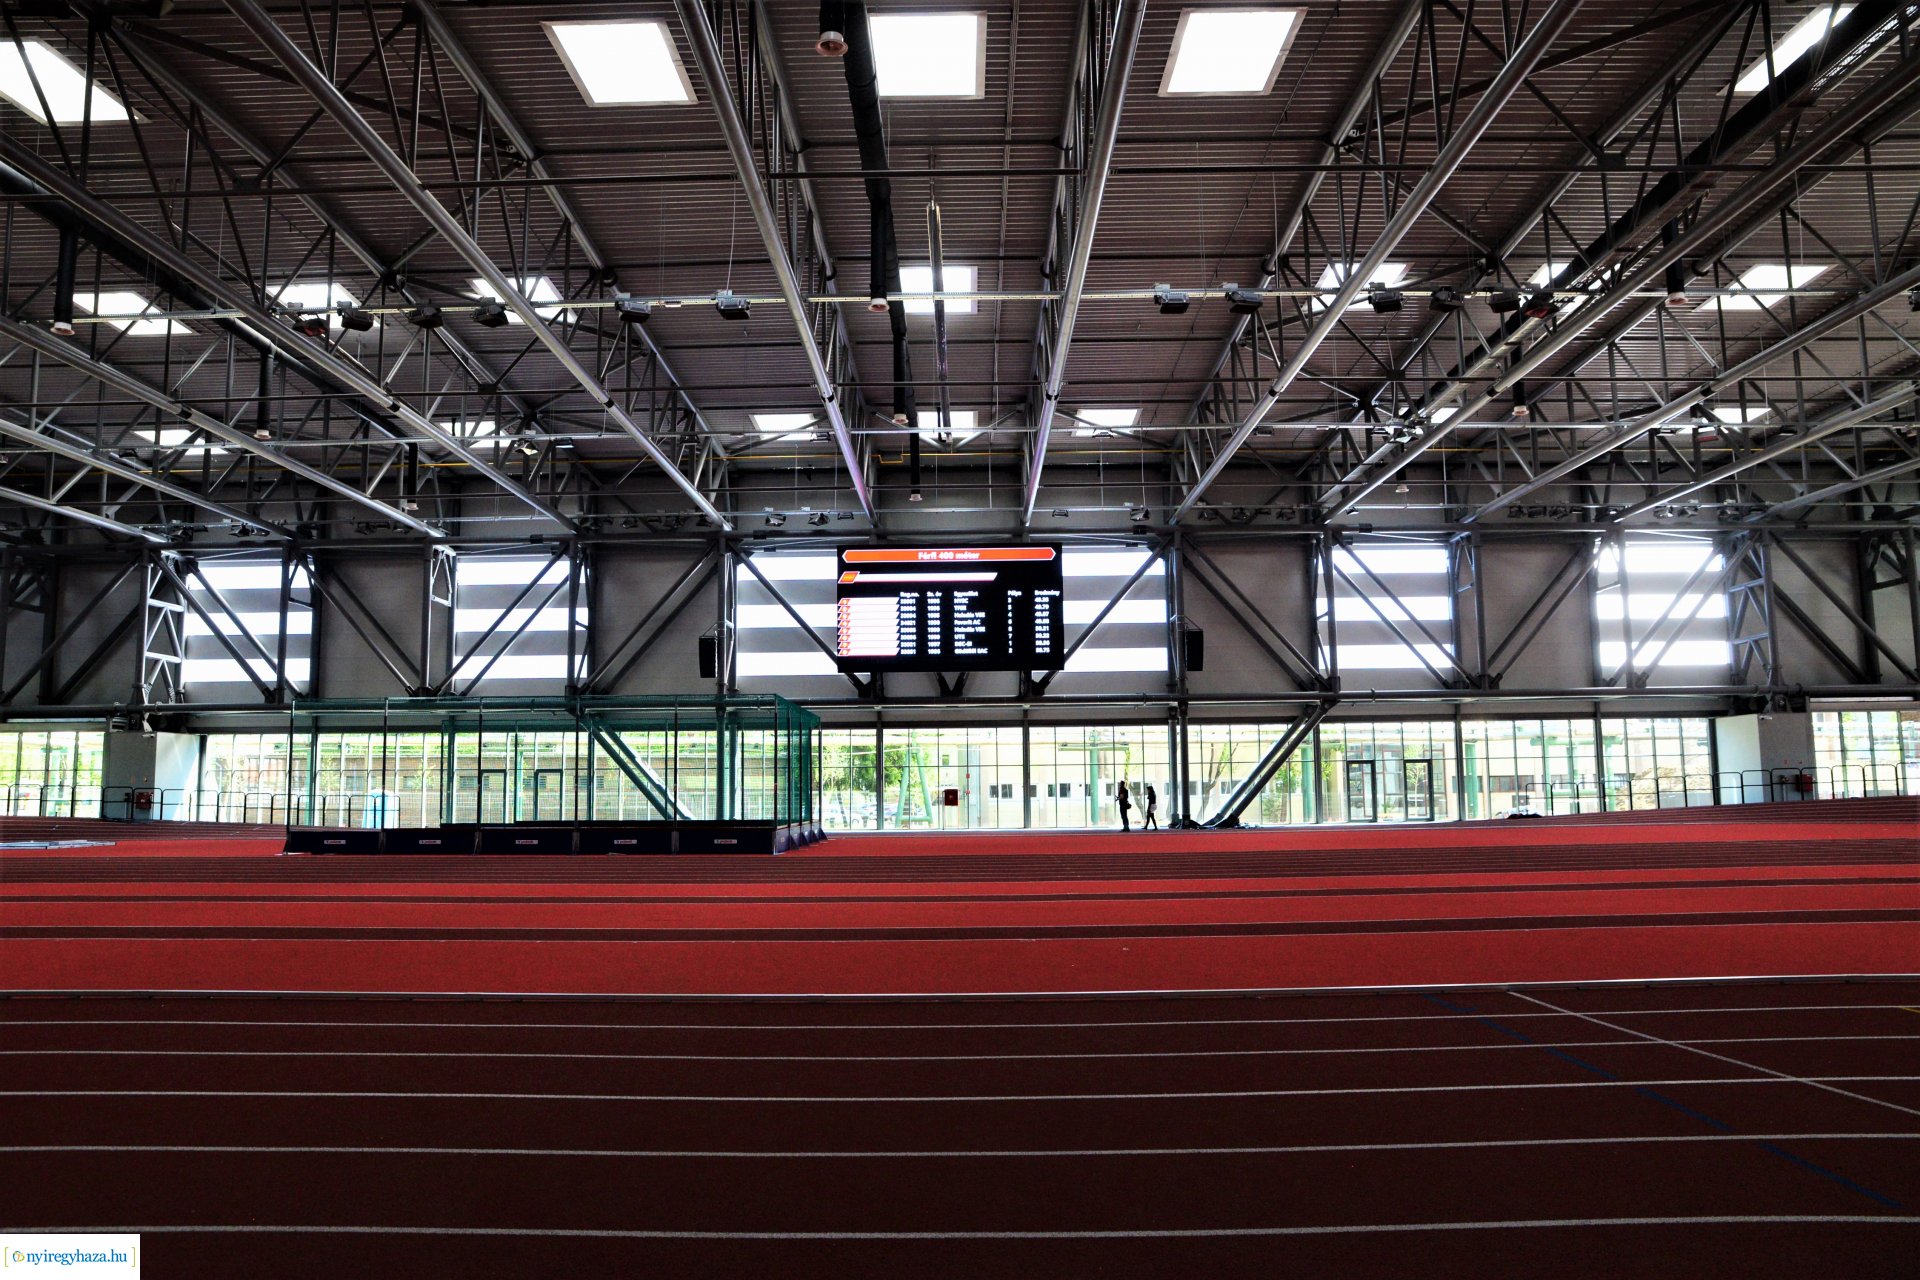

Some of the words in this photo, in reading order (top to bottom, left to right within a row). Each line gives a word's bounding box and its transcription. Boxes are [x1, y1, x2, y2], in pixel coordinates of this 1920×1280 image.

[918, 551, 937, 560] Férfi
[938, 551, 954, 560] 400
[955, 551, 980, 560] méter
